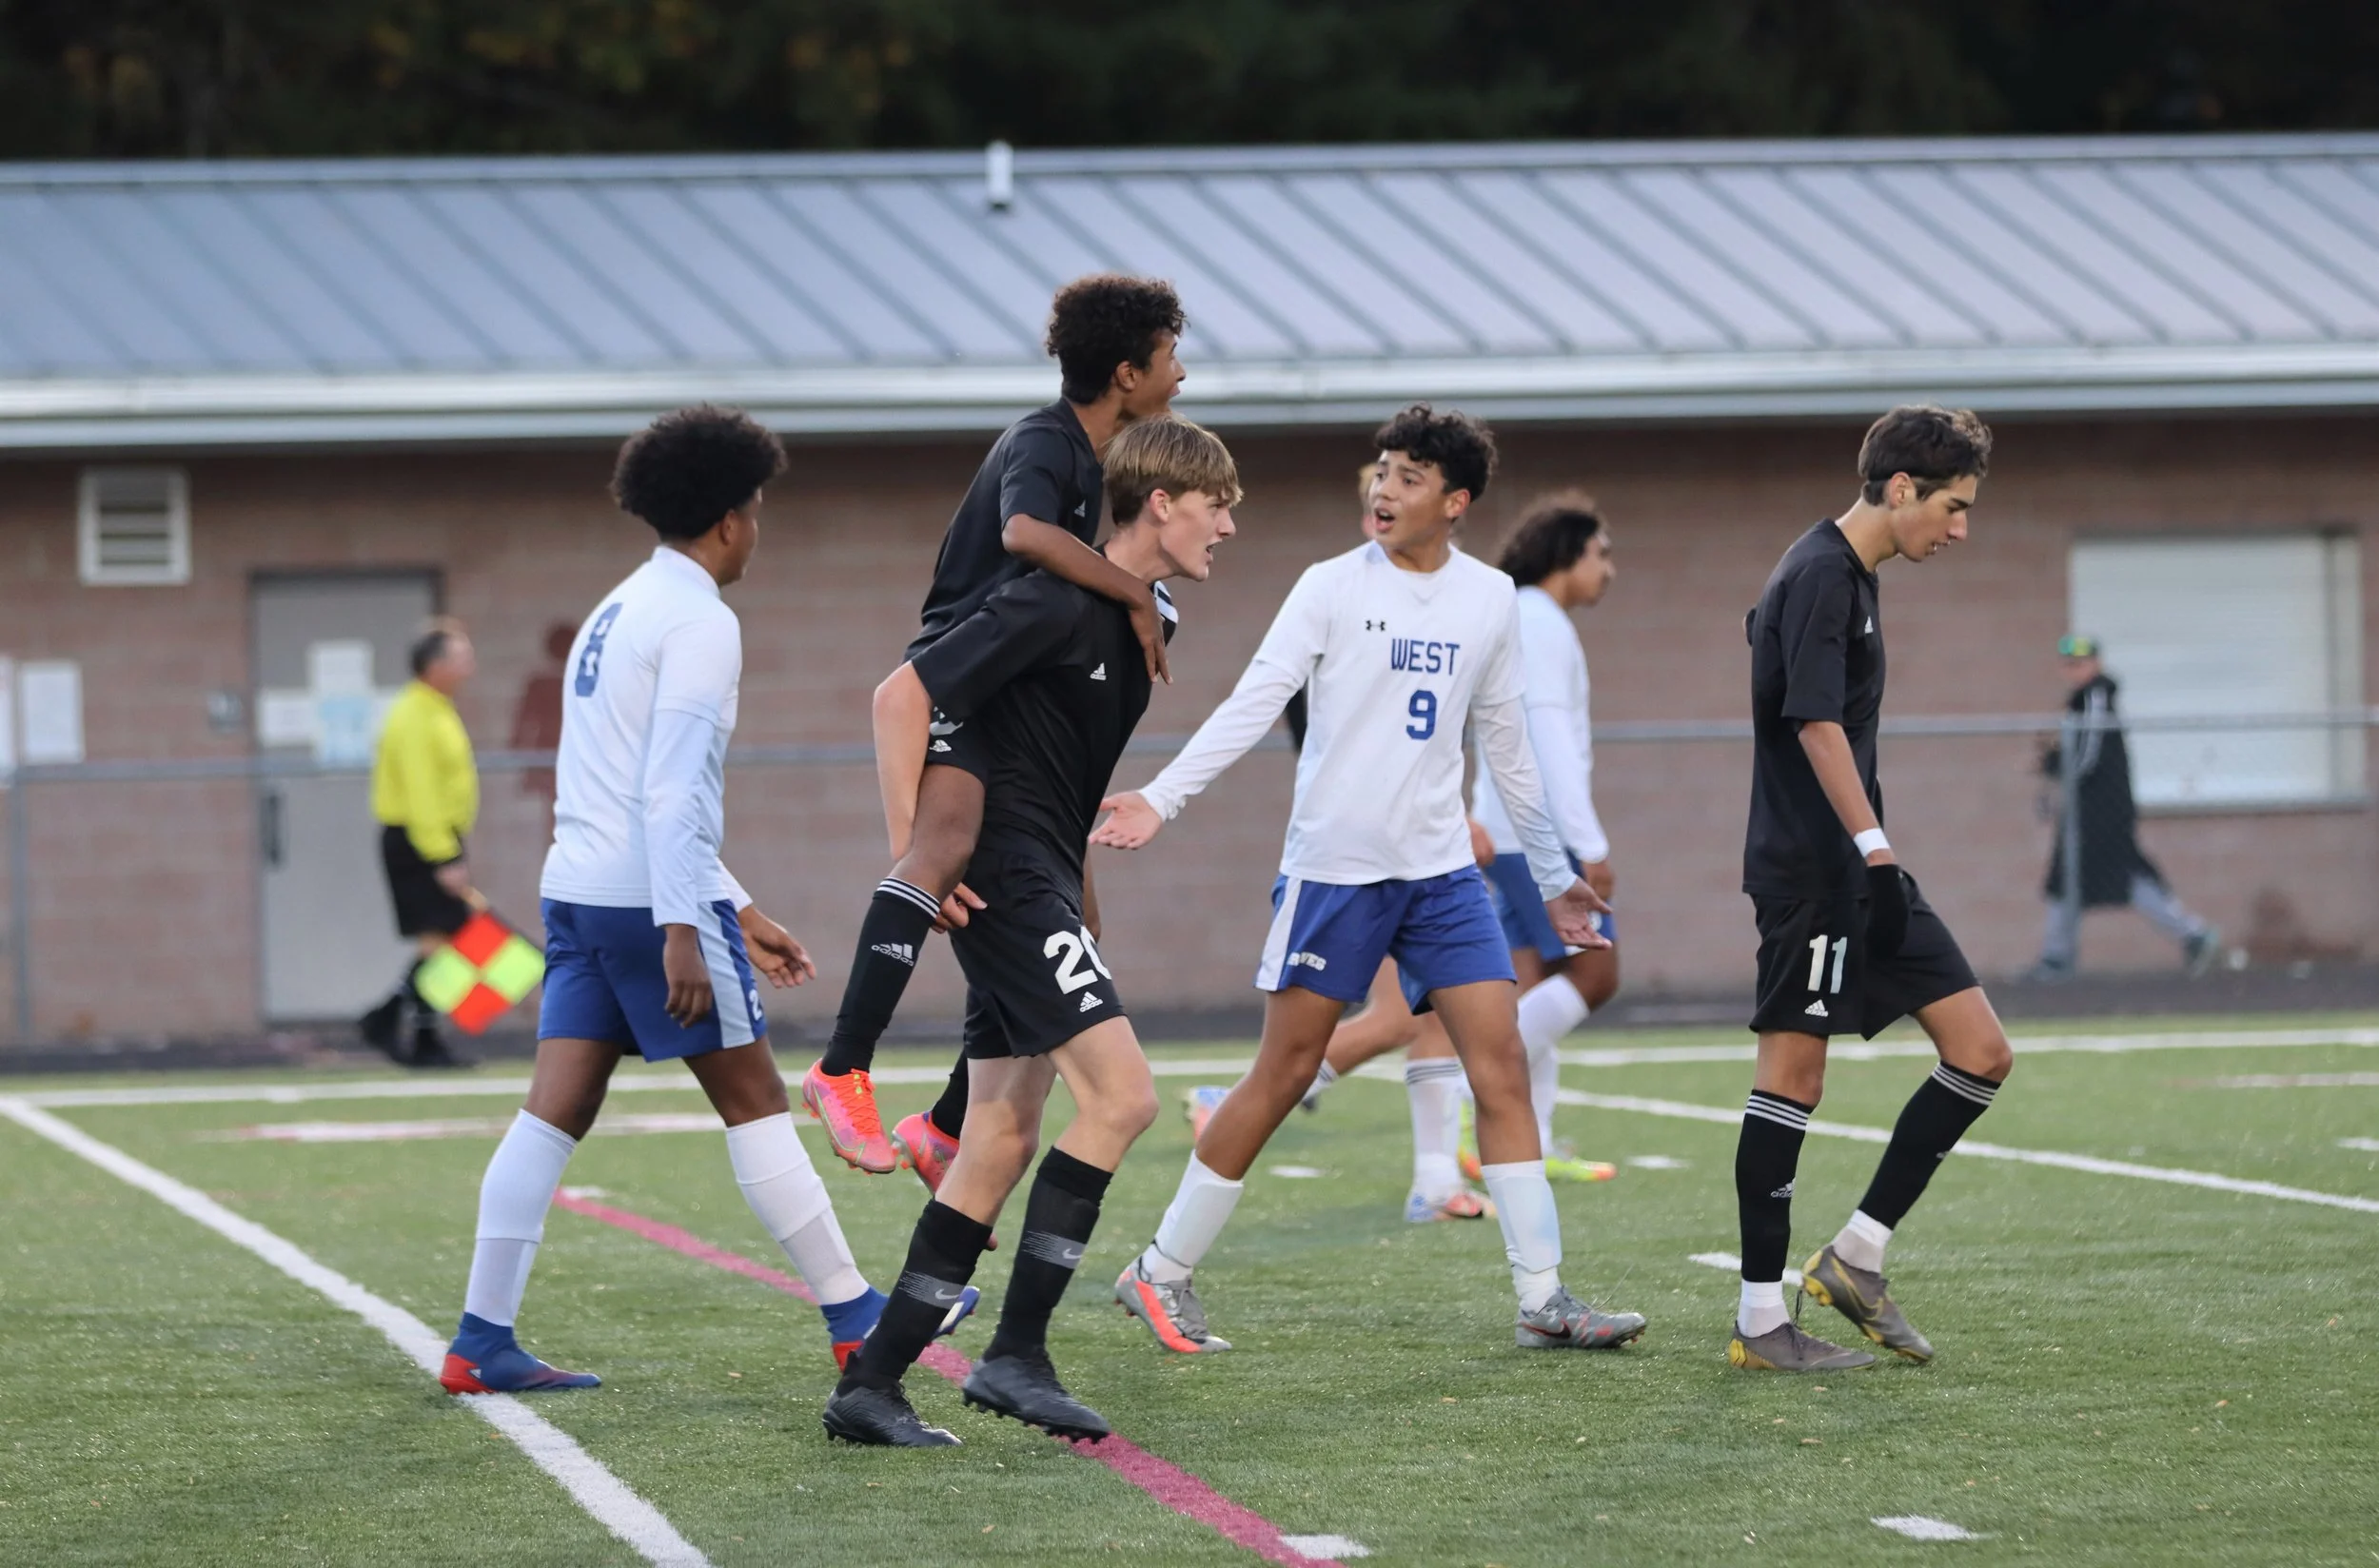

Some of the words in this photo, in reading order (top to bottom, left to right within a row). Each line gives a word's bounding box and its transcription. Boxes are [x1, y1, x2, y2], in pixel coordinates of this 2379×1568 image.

[574, 601, 623, 698] 8
[1390, 637, 1462, 676] WEST
[1406, 689, 1438, 741] 9
[870, 943, 915, 968] adidas
[1806, 933, 1849, 995] 11
